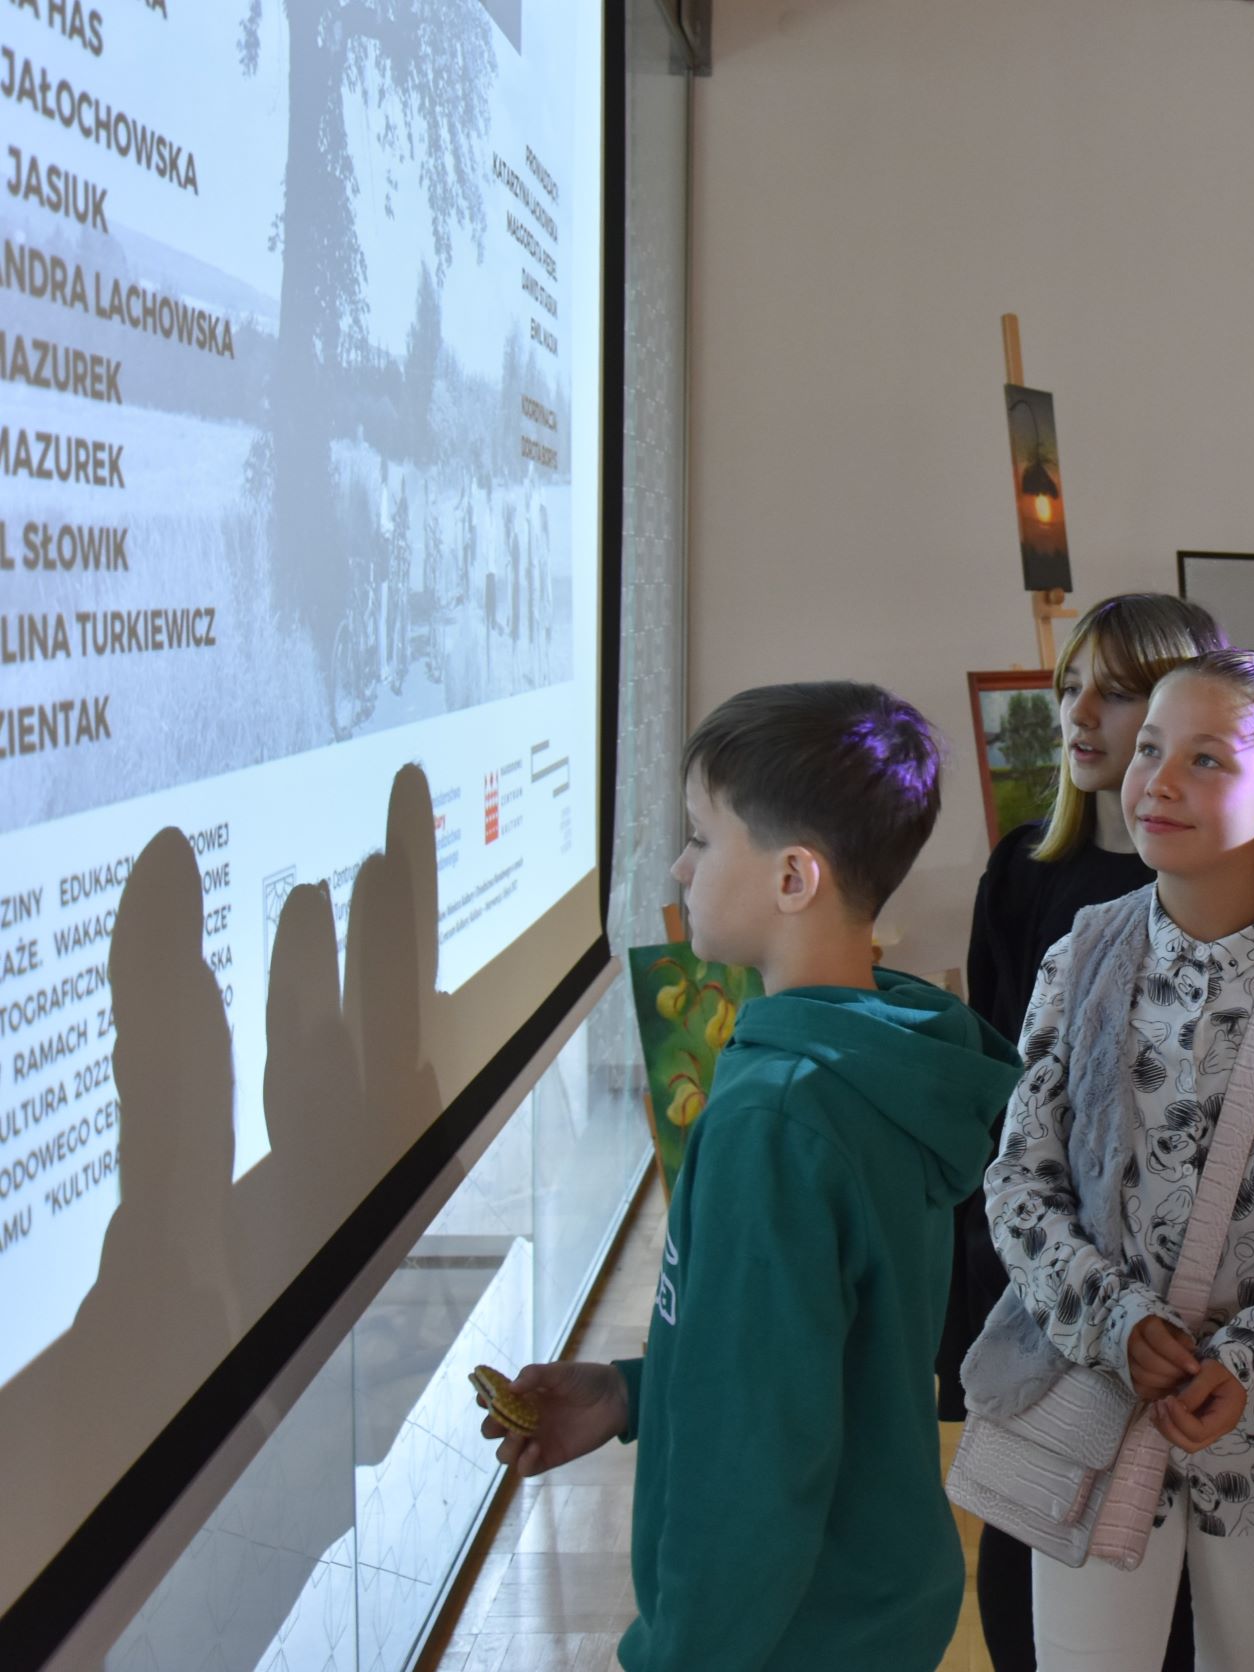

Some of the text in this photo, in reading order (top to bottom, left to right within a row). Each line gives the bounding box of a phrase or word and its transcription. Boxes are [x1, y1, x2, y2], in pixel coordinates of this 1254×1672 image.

[48, 0, 103, 57] HAS
[1, 46, 199, 196] JAŁOCHOWSKA
[7, 144, 109, 234] JASIUK
[0, 238, 235, 360] NDRA LACHOWSKA
[0, 329, 122, 403] AZUREK
[22, 519, 130, 572] SŁOWIK
[2, 606, 217, 664] LINA TURKIEWICZ
[13, 1017, 88, 1085] RAMACH
